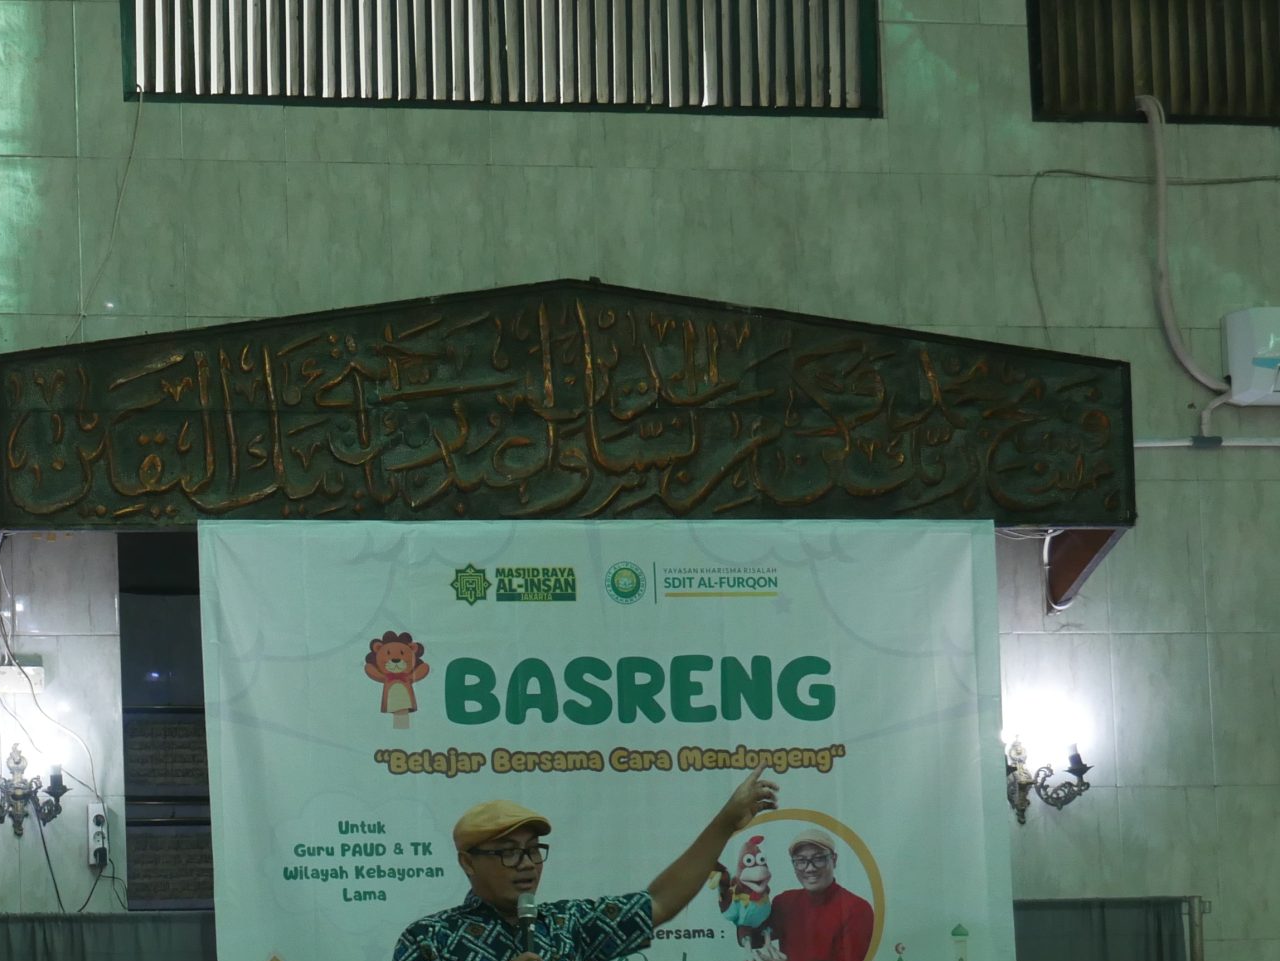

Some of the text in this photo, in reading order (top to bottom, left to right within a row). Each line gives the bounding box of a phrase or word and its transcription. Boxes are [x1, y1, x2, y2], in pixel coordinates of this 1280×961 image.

[495, 567, 575, 579] MASJID RAYA
[496, 578, 576, 592] AL-INSAN
[664, 576, 778, 590] SDIT AL-FURQON
[444, 654, 837, 726] BASRENG
[491, 746, 605, 774] Bersama
[609, 747, 672, 772] Cara
[338, 820, 386, 835] Untuk
[293, 841, 433, 858] Guru PAUD & TK
[283, 865, 444, 882] Wilayah Kebayoran
[342, 887, 387, 902] Lama
[650, 927, 715, 940] ersama
